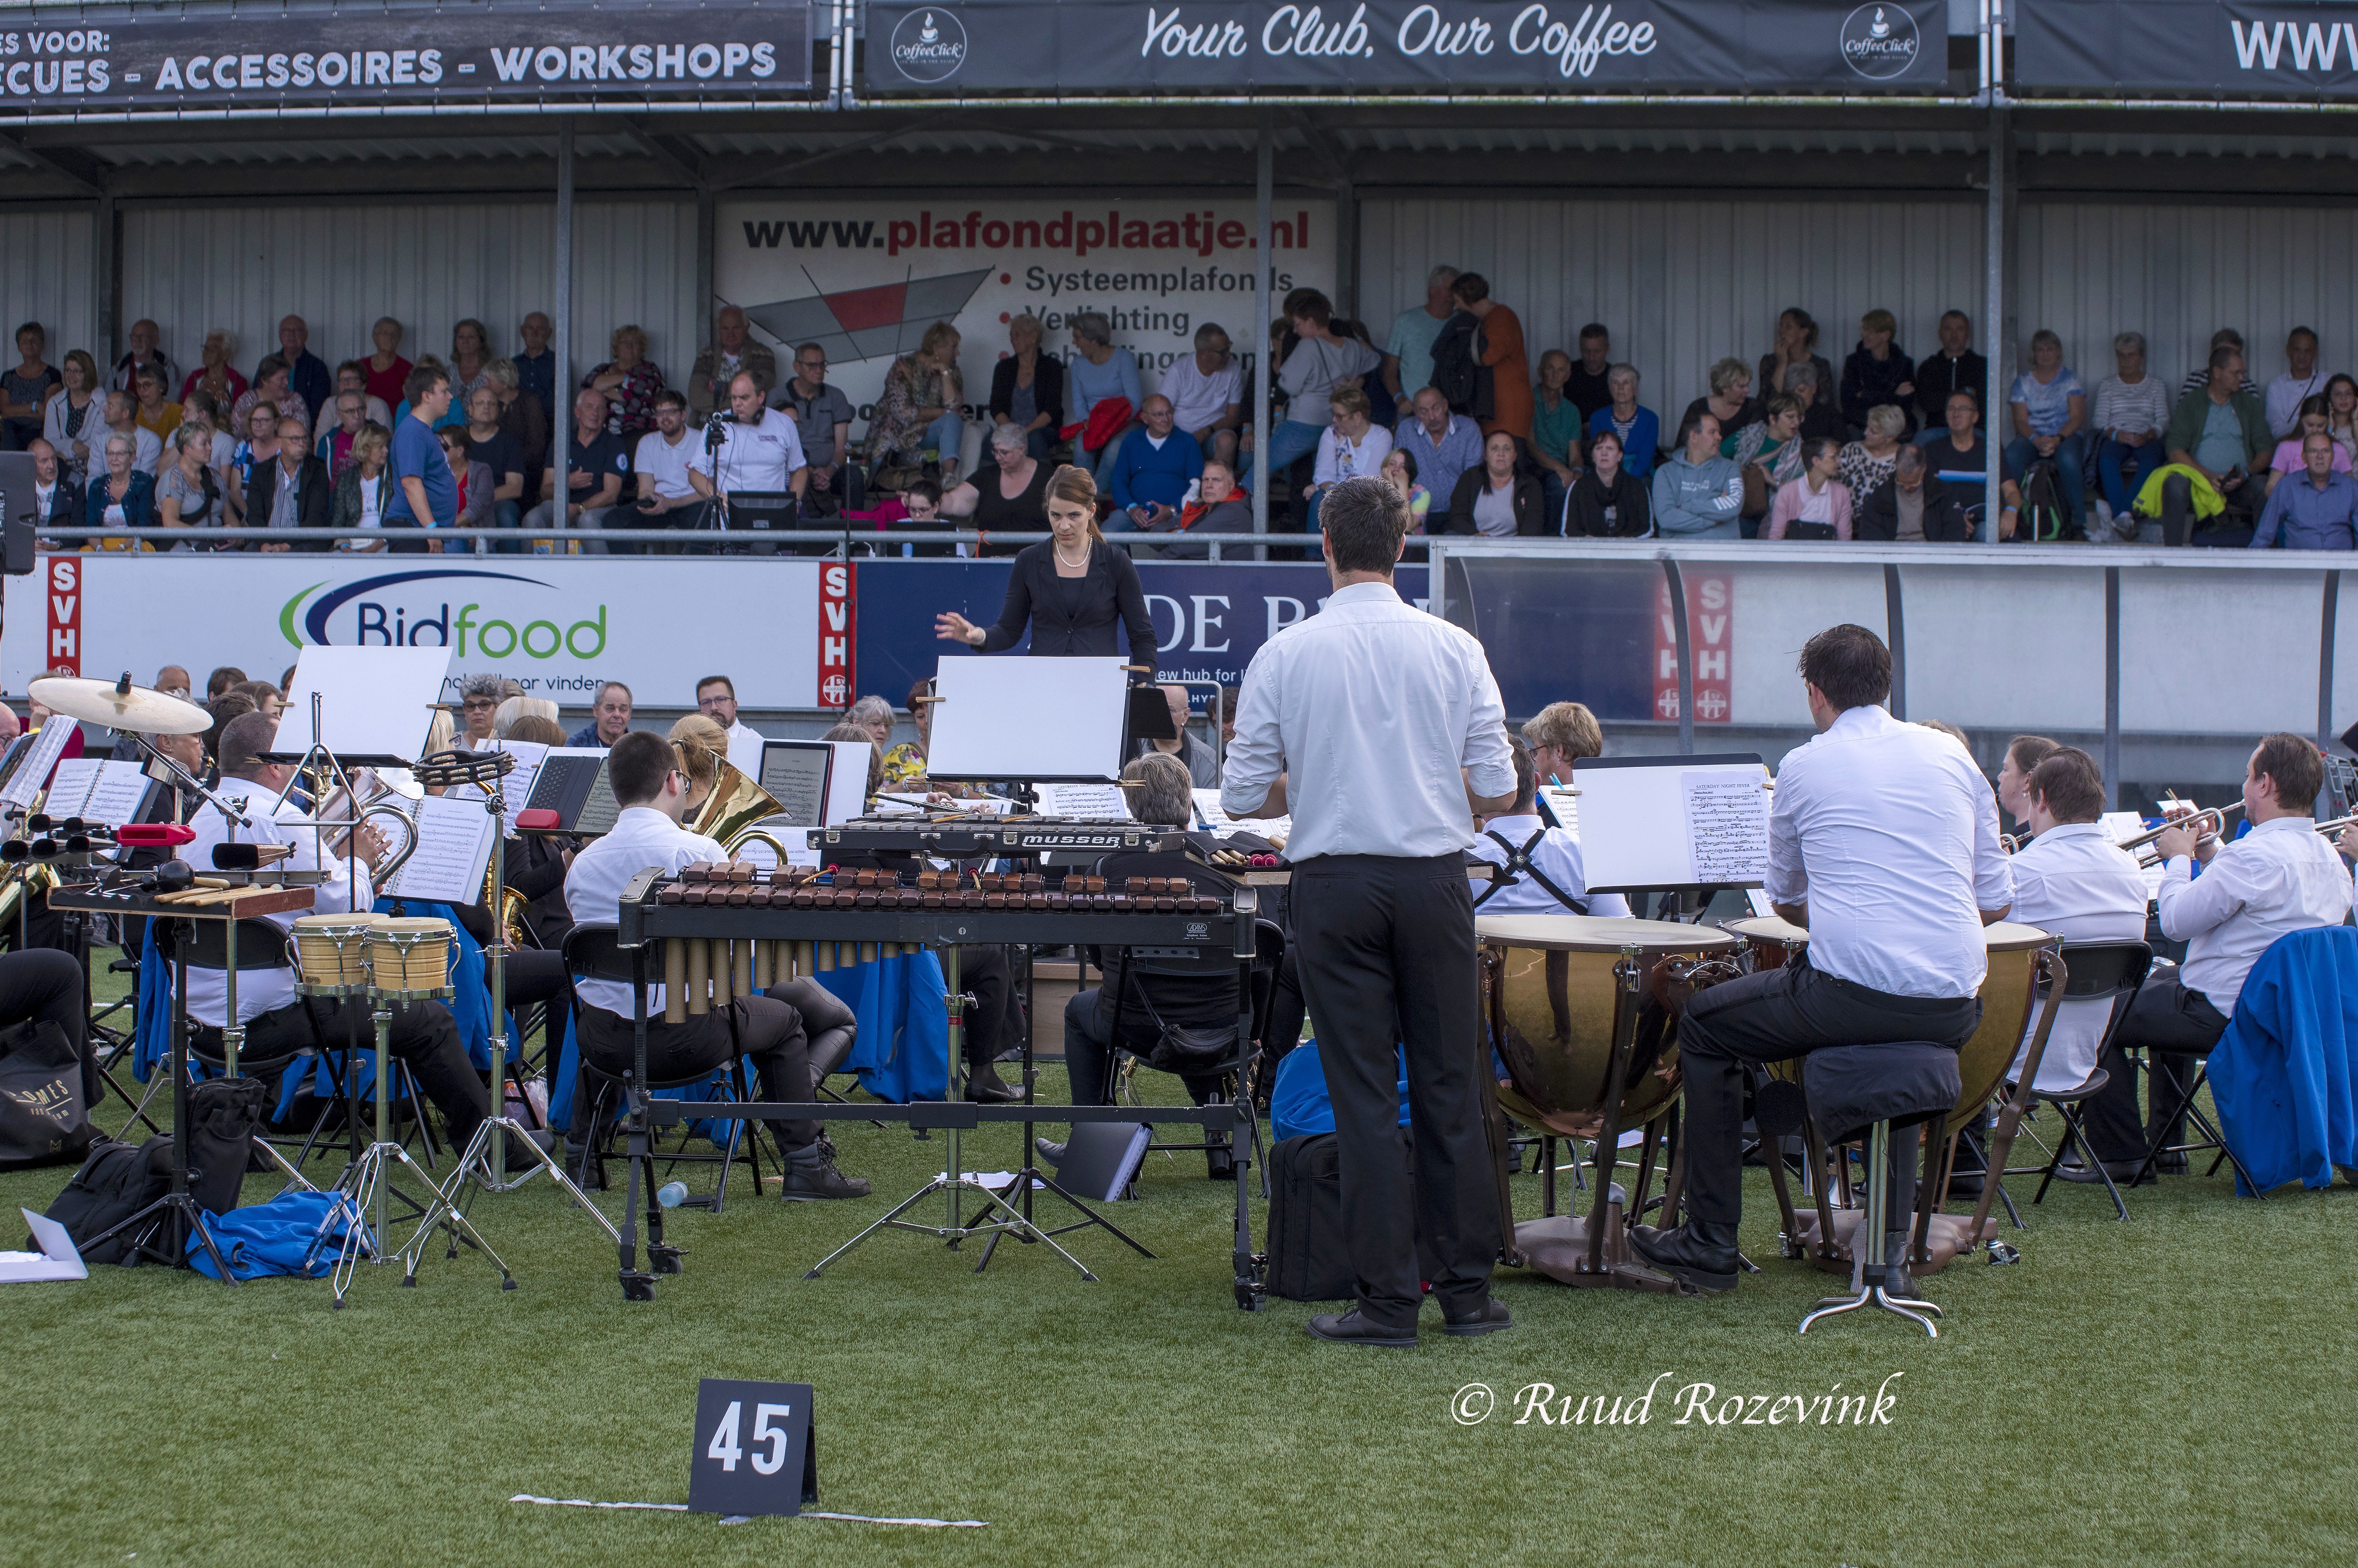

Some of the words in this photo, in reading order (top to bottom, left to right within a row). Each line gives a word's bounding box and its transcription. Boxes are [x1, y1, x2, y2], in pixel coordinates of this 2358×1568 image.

[0, 32, 19, 55] S
[28, 30, 110, 54] VOOR:
[0, 59, 110, 95] CUES
[155, 48, 442, 90] ACCESSOIRES
[490, 42, 776, 81] WORKSHOPS
[1142, 8, 1247, 58] Your
[1398, 4, 1494, 55] Our
[1509, 4, 1657, 77] Coffee
[2231, 20, 2358, 71] WW
[743, 210, 1309, 256] www.plafondplaatje.nl
[52, 562, 76, 657] SVH
[358, 603, 607, 659] Bidfood
[824, 567, 846, 665] SVH
[1698, 579, 1727, 680] SVH
[1183, 668, 1210, 681] hub
[1215, 669, 1236, 682] for
[708, 1401, 790, 1475] 45
